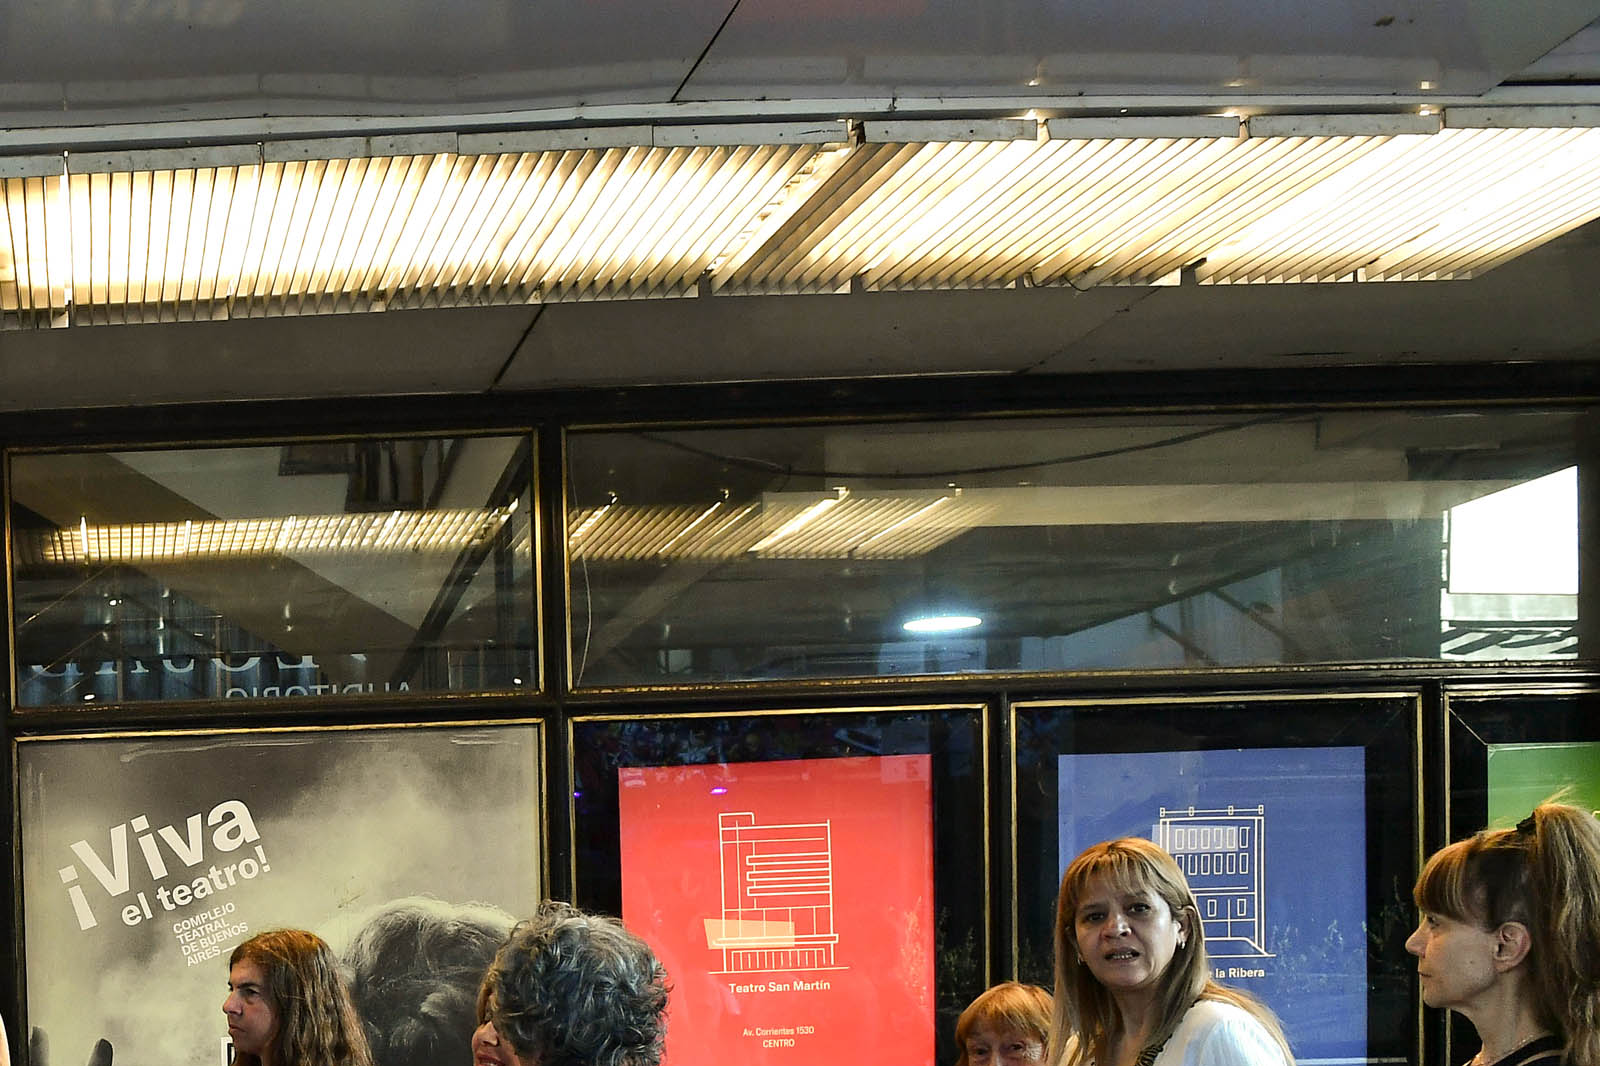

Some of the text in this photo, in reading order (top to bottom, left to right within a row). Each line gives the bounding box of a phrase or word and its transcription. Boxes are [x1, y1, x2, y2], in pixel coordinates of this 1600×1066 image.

[58, 800, 261, 931] ¡Viva
[121, 845, 271, 926] el teatro!
[173, 902, 235, 934] COMPLEJO
[176, 918, 230, 945] TEATRAL
[181, 922, 249, 956] DE BUENOS
[186, 946, 221, 967] AIRES
[1215, 968, 1226, 978] la
[1228, 967, 1265, 978] Ribera
[728, 980, 831, 993] Teatro San Martín
[743, 1026, 815, 1036] Av. Corrientes 1530
[762, 1039, 795, 1048] CENTRO
